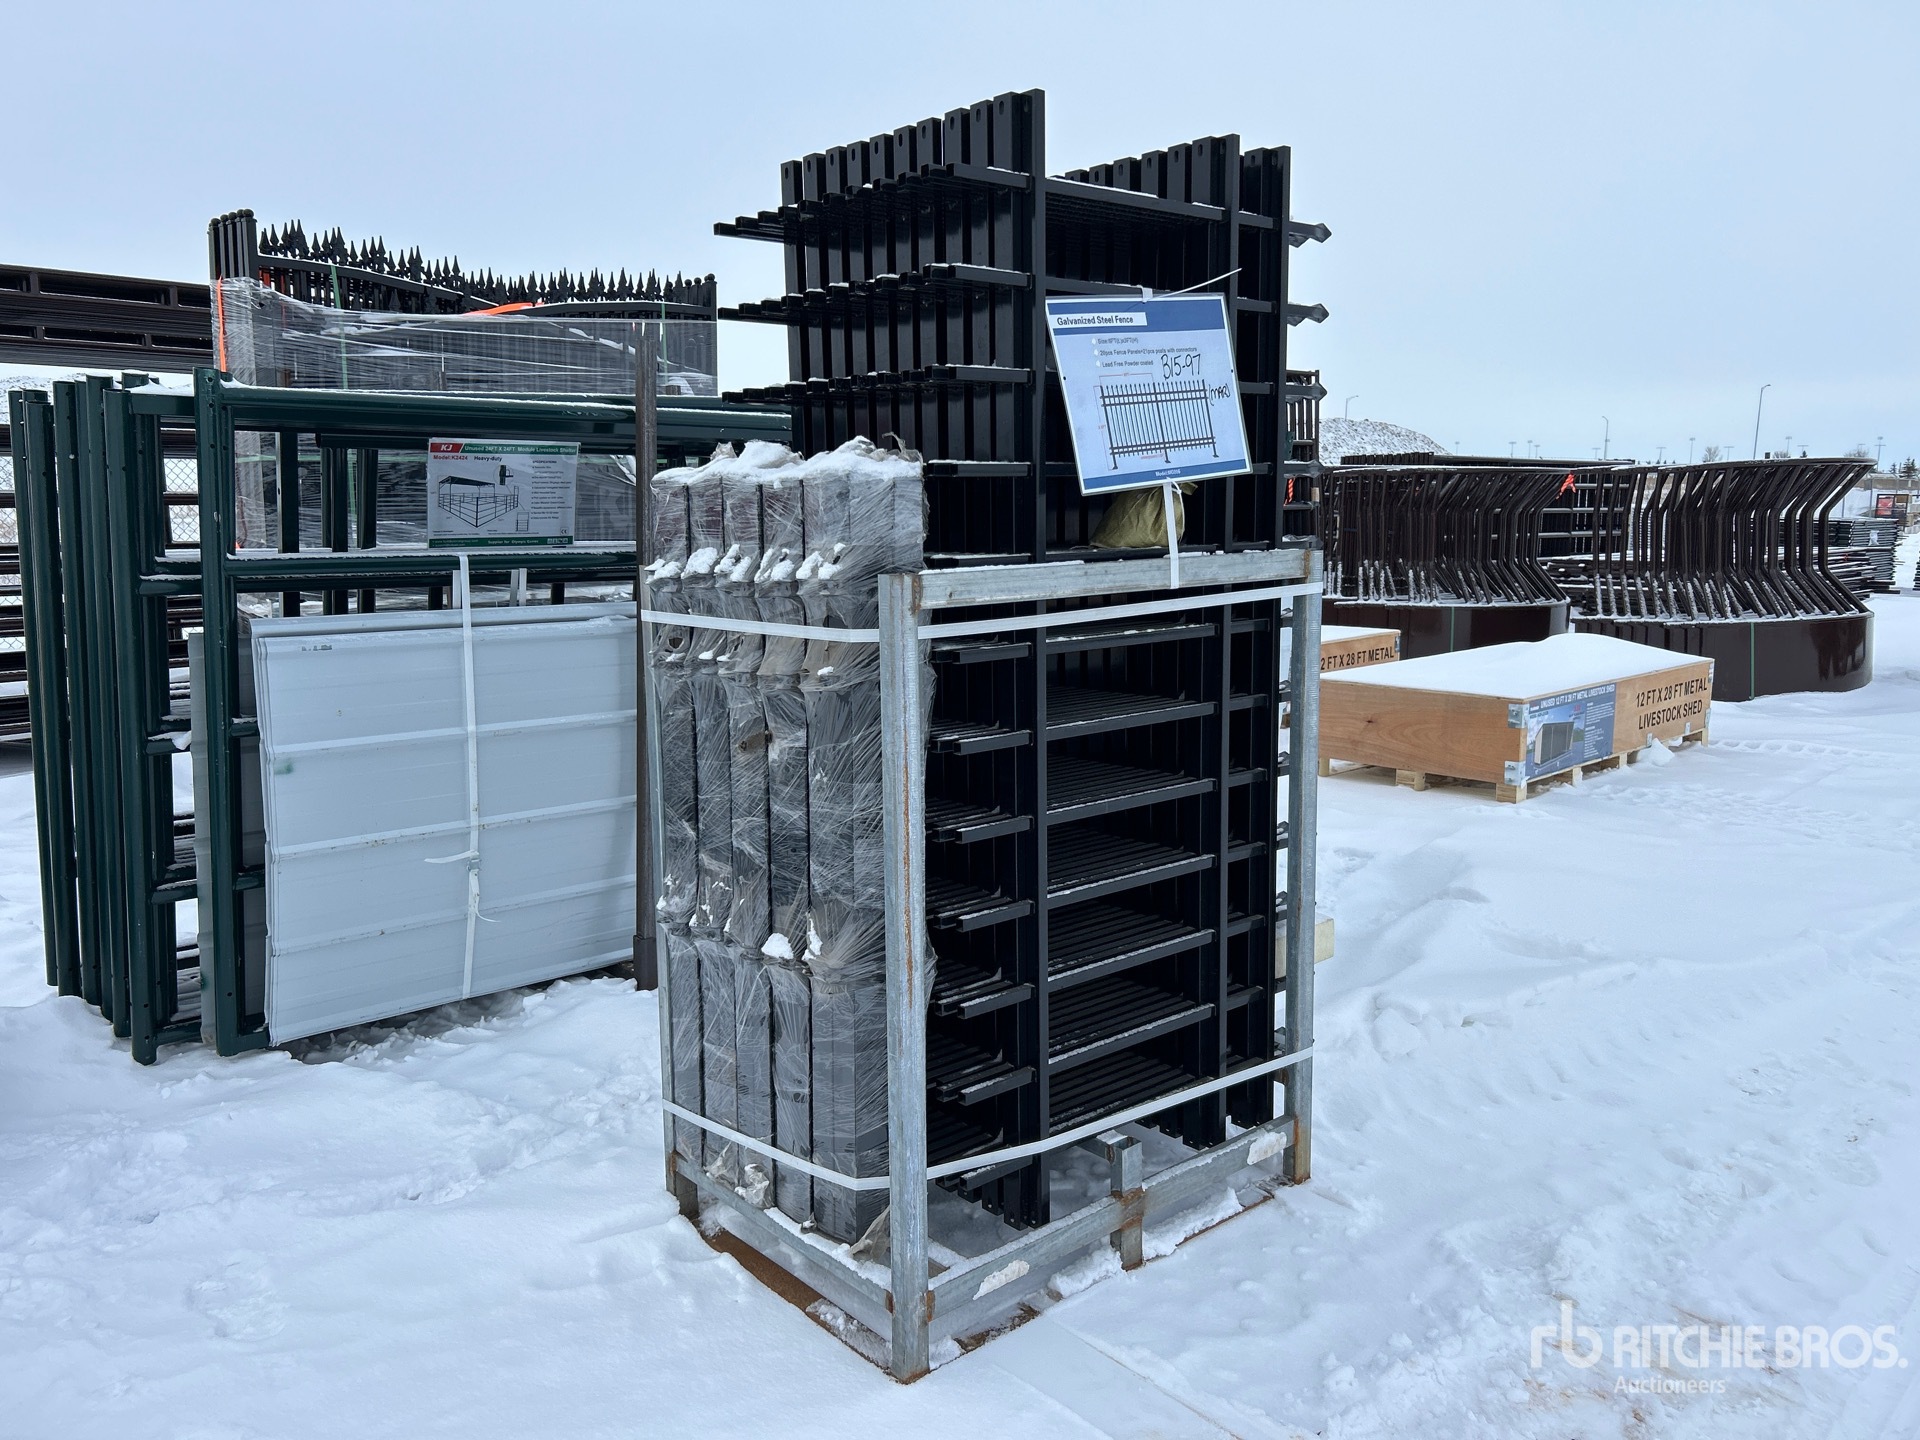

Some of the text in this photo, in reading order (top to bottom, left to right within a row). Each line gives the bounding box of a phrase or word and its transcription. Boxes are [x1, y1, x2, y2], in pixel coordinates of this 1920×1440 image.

[1057, 315, 1133, 326] Galvanized Steel Fence
[1161, 353, 1201, 380] B15-97
[1327, 655, 1337, 669] FT
[1339, 654, 1345, 667] X
[1346, 652, 1355, 666] 28
[1357, 650, 1366, 664] FT
[1368, 646, 1394, 662] METAL
[1540, 698, 1555, 708] UNUSED
[1577, 690, 1588, 700] METAL
[1588, 686, 1605, 698] LIVESTOCK
[1606, 684, 1615, 693] SHED
[1636, 677, 1707, 708] 12 FT X 28 FT METAL
[1638, 704, 1682, 730] LIVESTOCK
[1683, 699, 1702, 717] SHED
